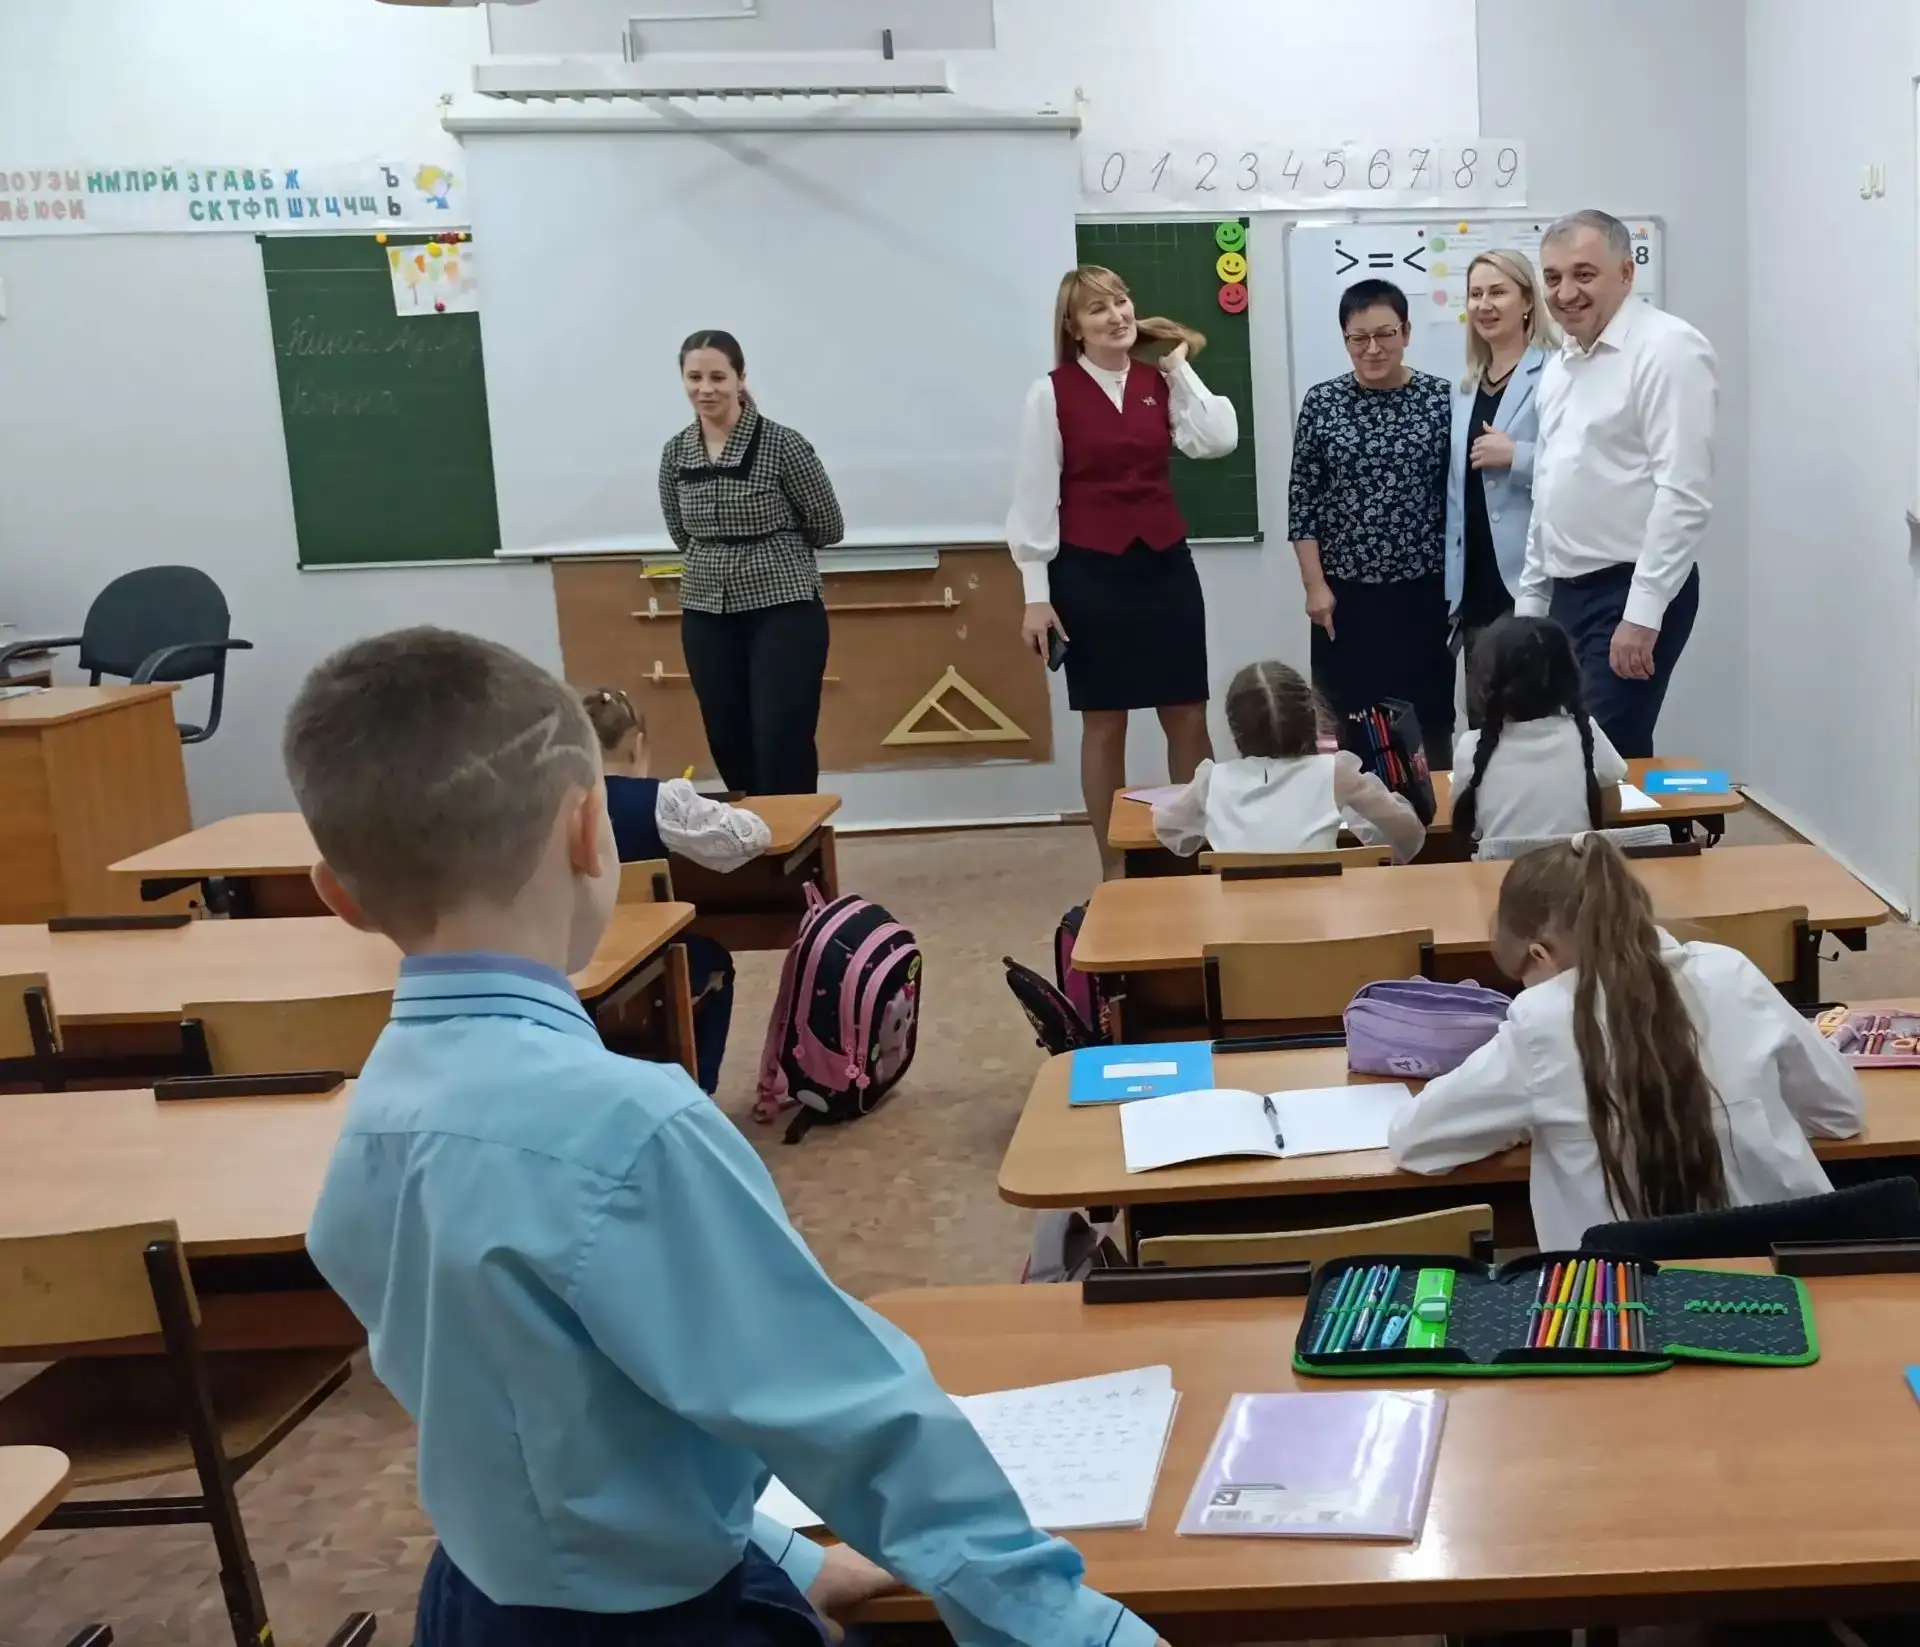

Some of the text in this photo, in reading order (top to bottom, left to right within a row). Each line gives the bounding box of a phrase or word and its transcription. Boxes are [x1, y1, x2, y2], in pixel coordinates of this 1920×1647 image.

[1101, 148, 1519, 193] 0 1 2 3 4 5 6 7 8 9
